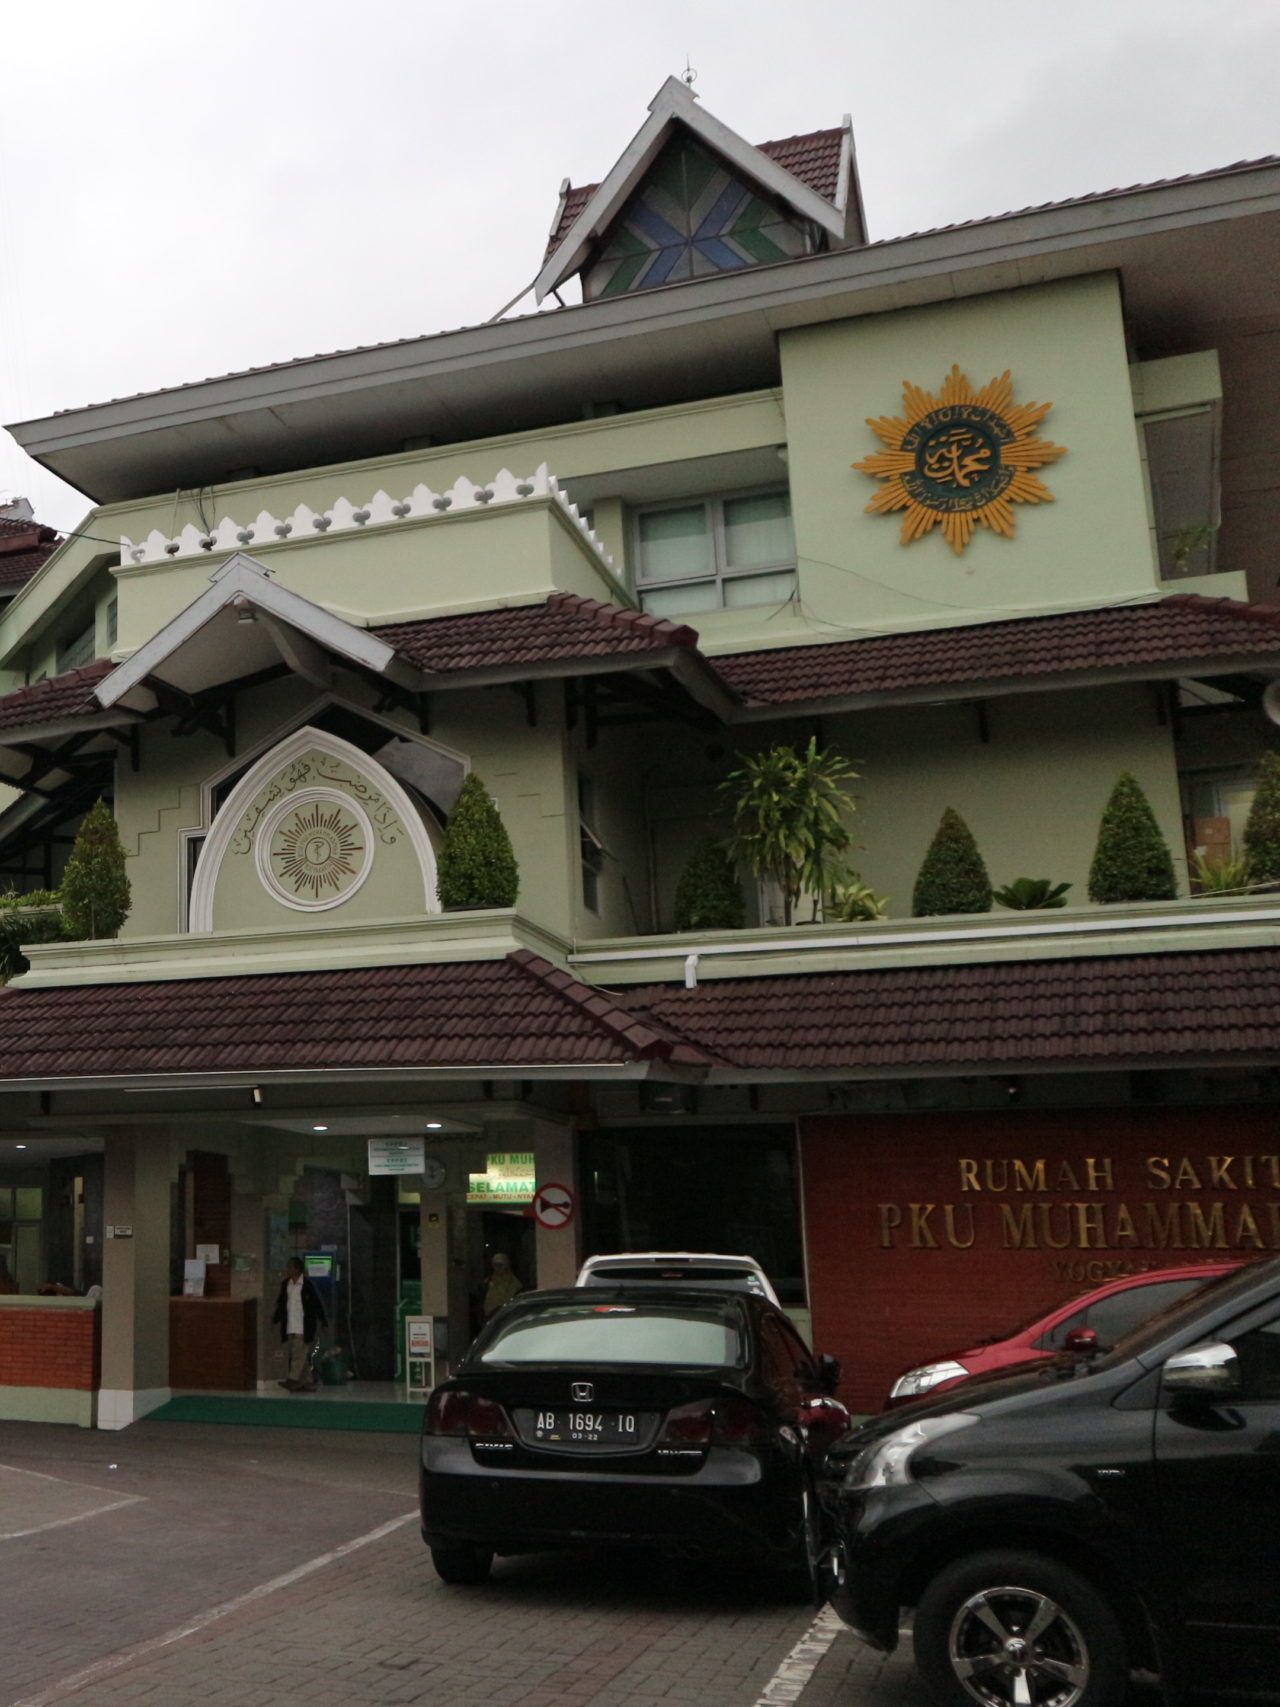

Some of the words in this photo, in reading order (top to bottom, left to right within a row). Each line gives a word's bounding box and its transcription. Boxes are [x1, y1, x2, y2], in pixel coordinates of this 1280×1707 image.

[958, 1157, 1115, 1192] RUMAH
[1145, 1154, 1280, 1191] SAKIT
[877, 1202, 976, 1249] PKU
[537, 1412, 554, 1429] AB
[569, 1413, 603, 1431] 1694
